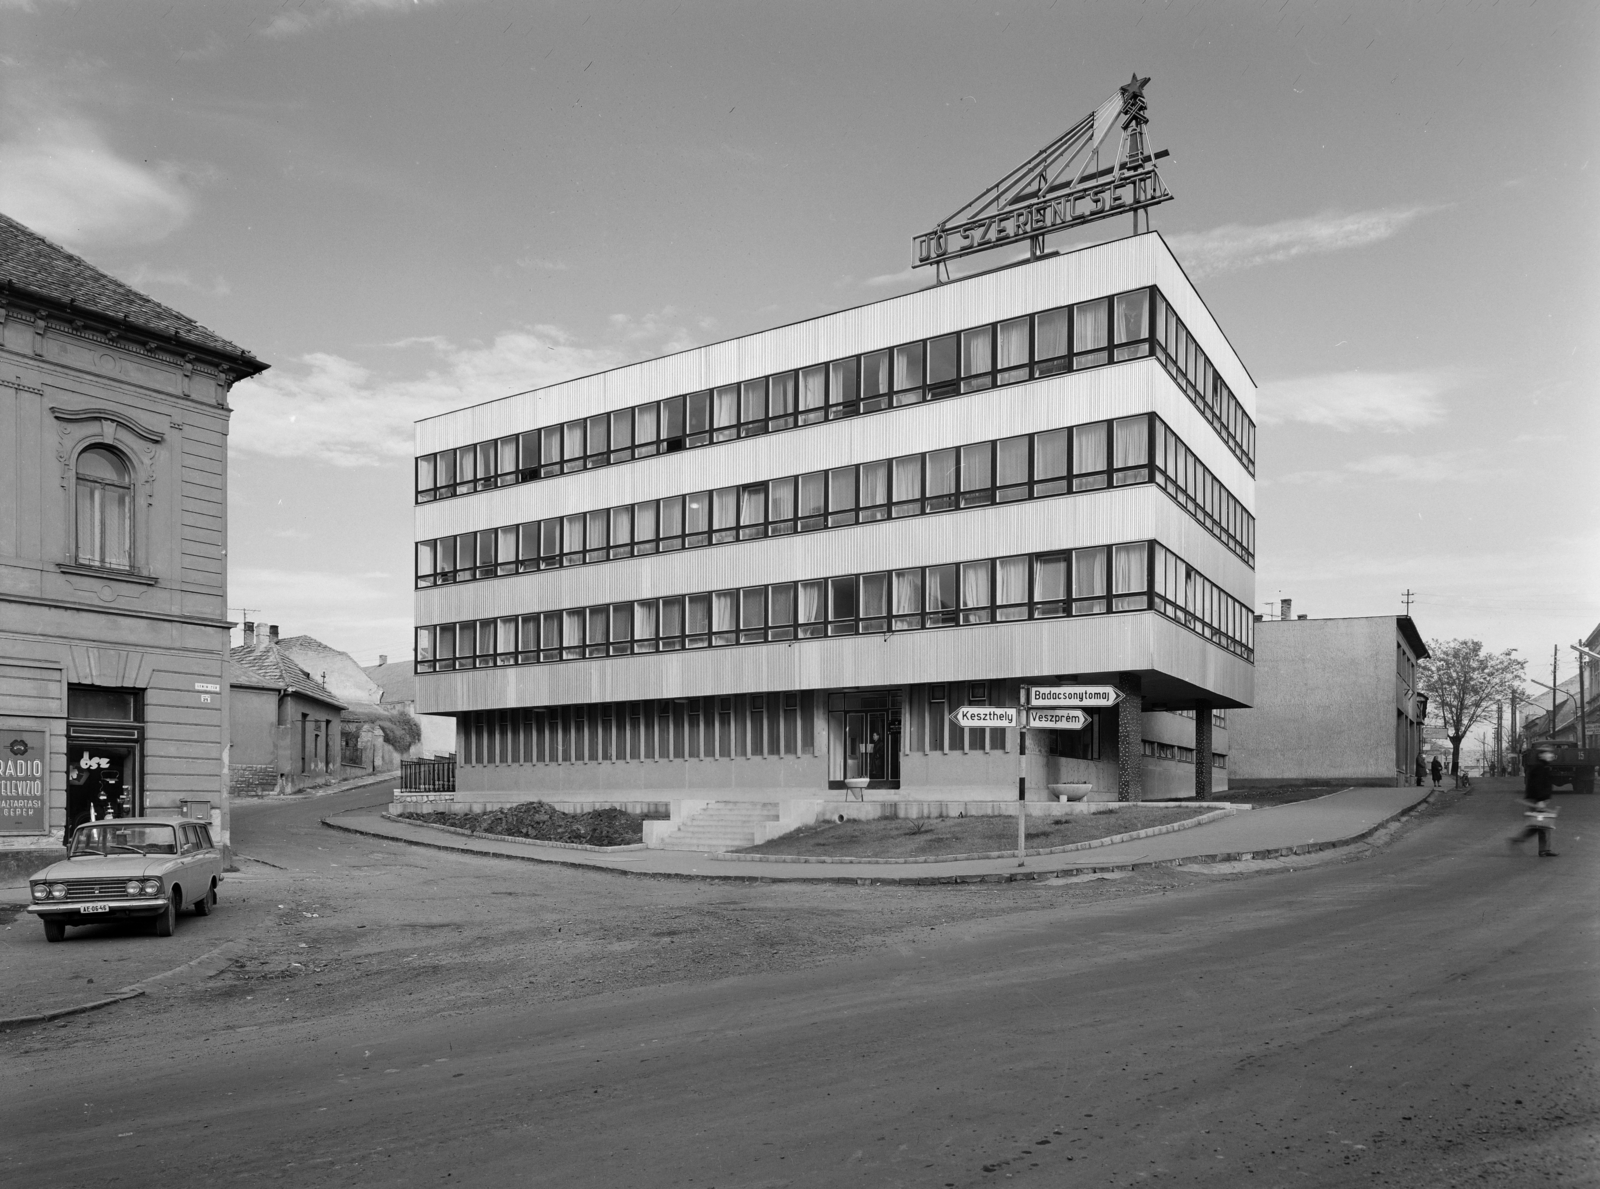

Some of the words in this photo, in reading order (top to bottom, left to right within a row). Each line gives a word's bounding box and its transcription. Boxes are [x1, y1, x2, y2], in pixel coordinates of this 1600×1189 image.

[1034, 690, 1110, 702] Badacsonytomaj
[961, 710, 1013, 724] Keszthely
[1031, 712, 1080, 725] Veszprém
